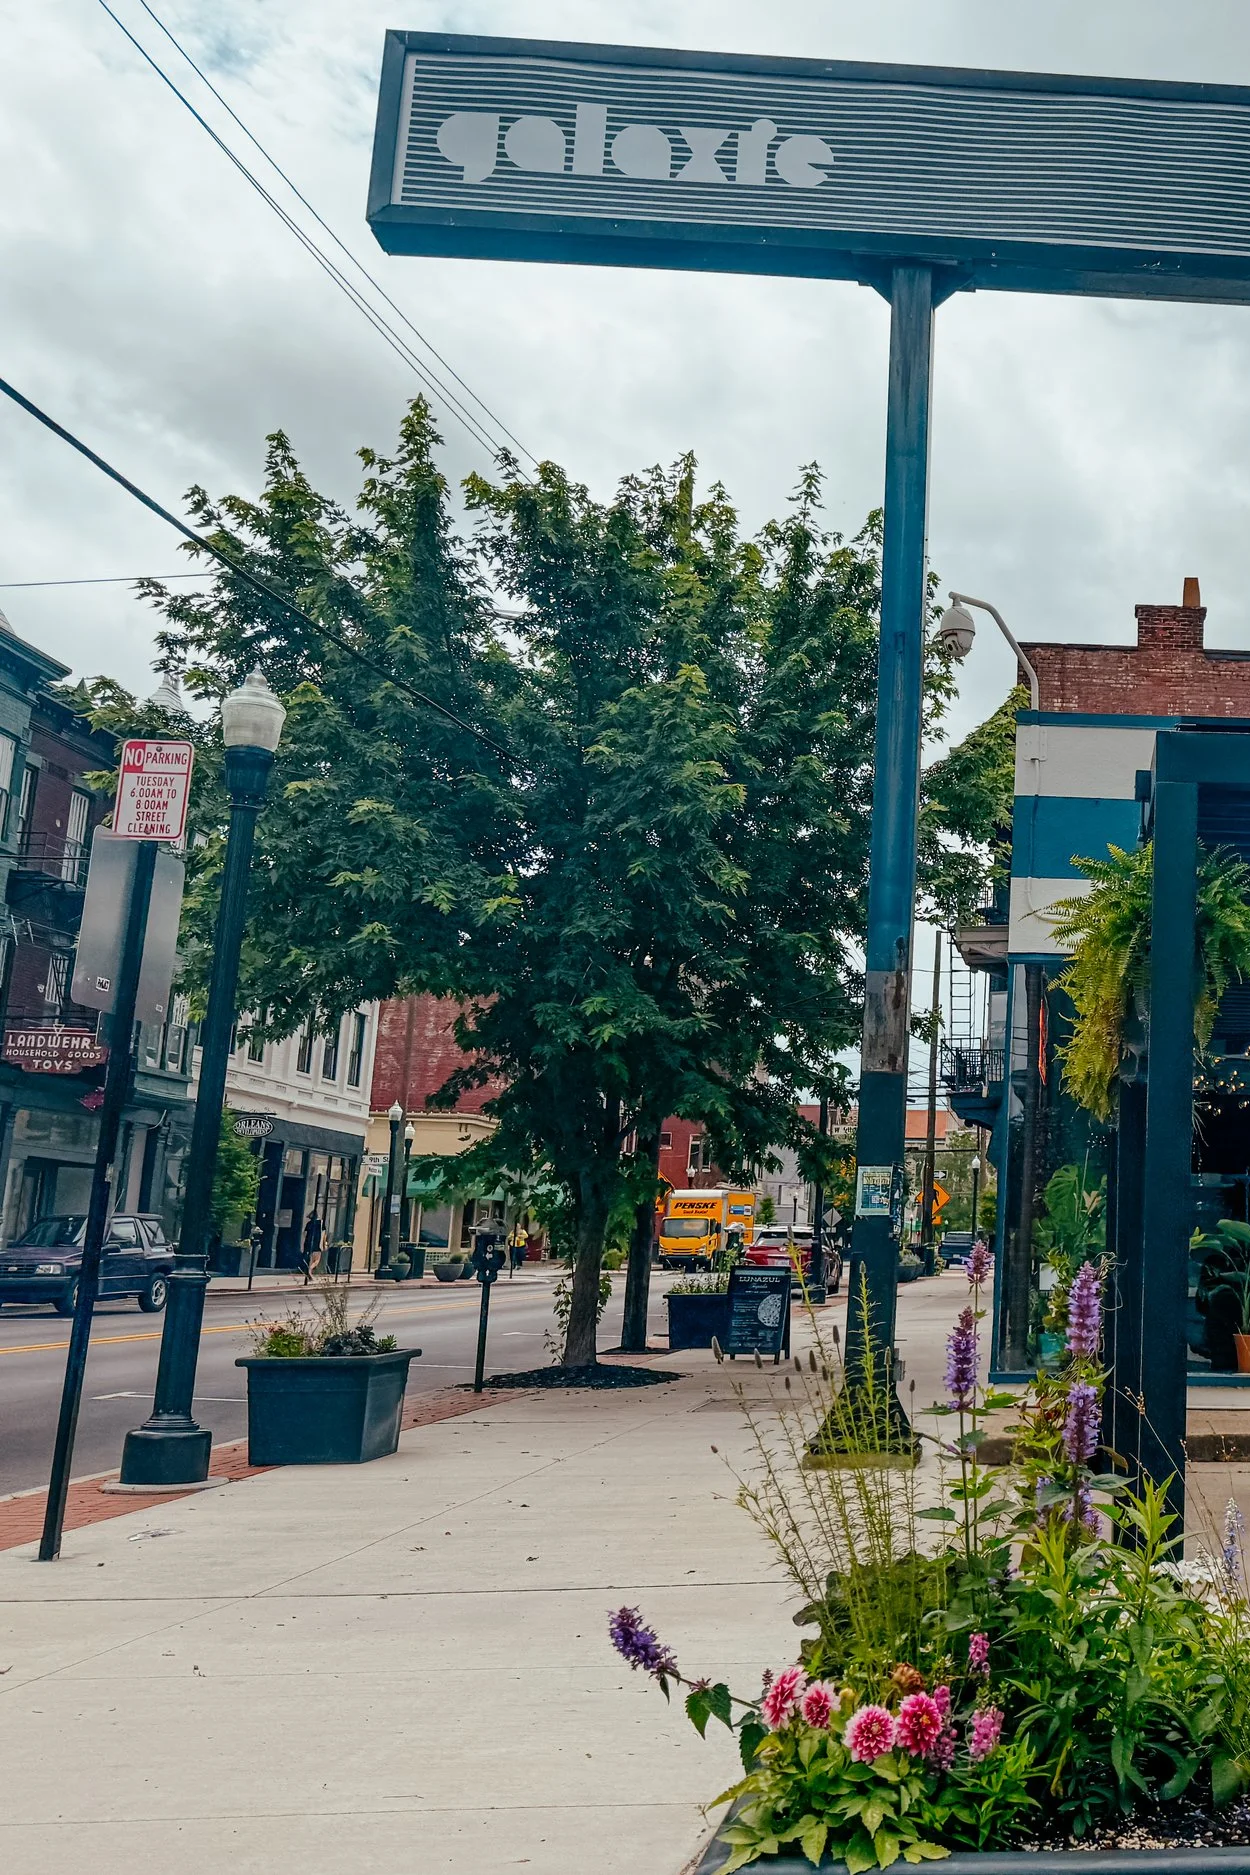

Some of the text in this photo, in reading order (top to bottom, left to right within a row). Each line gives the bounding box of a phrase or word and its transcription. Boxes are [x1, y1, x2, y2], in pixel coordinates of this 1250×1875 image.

[435, 103, 836, 188] galaxie
[125, 748, 188, 767] NO PARKING
[136, 776, 175, 787] TUESDAY
[167, 789, 177, 799] TO
[135, 812, 167, 822] STREET
[127, 823, 171, 834] CLEANING
[7, 1034, 102, 1050] LANDWEHR
[6, 1048, 101, 1059] HOUSEHOLD GOODS
[32, 1059, 73, 1070] TOYS
[235, 1119, 270, 1129] ORLEANS
[674, 1202, 717, 1210] PENSKE
